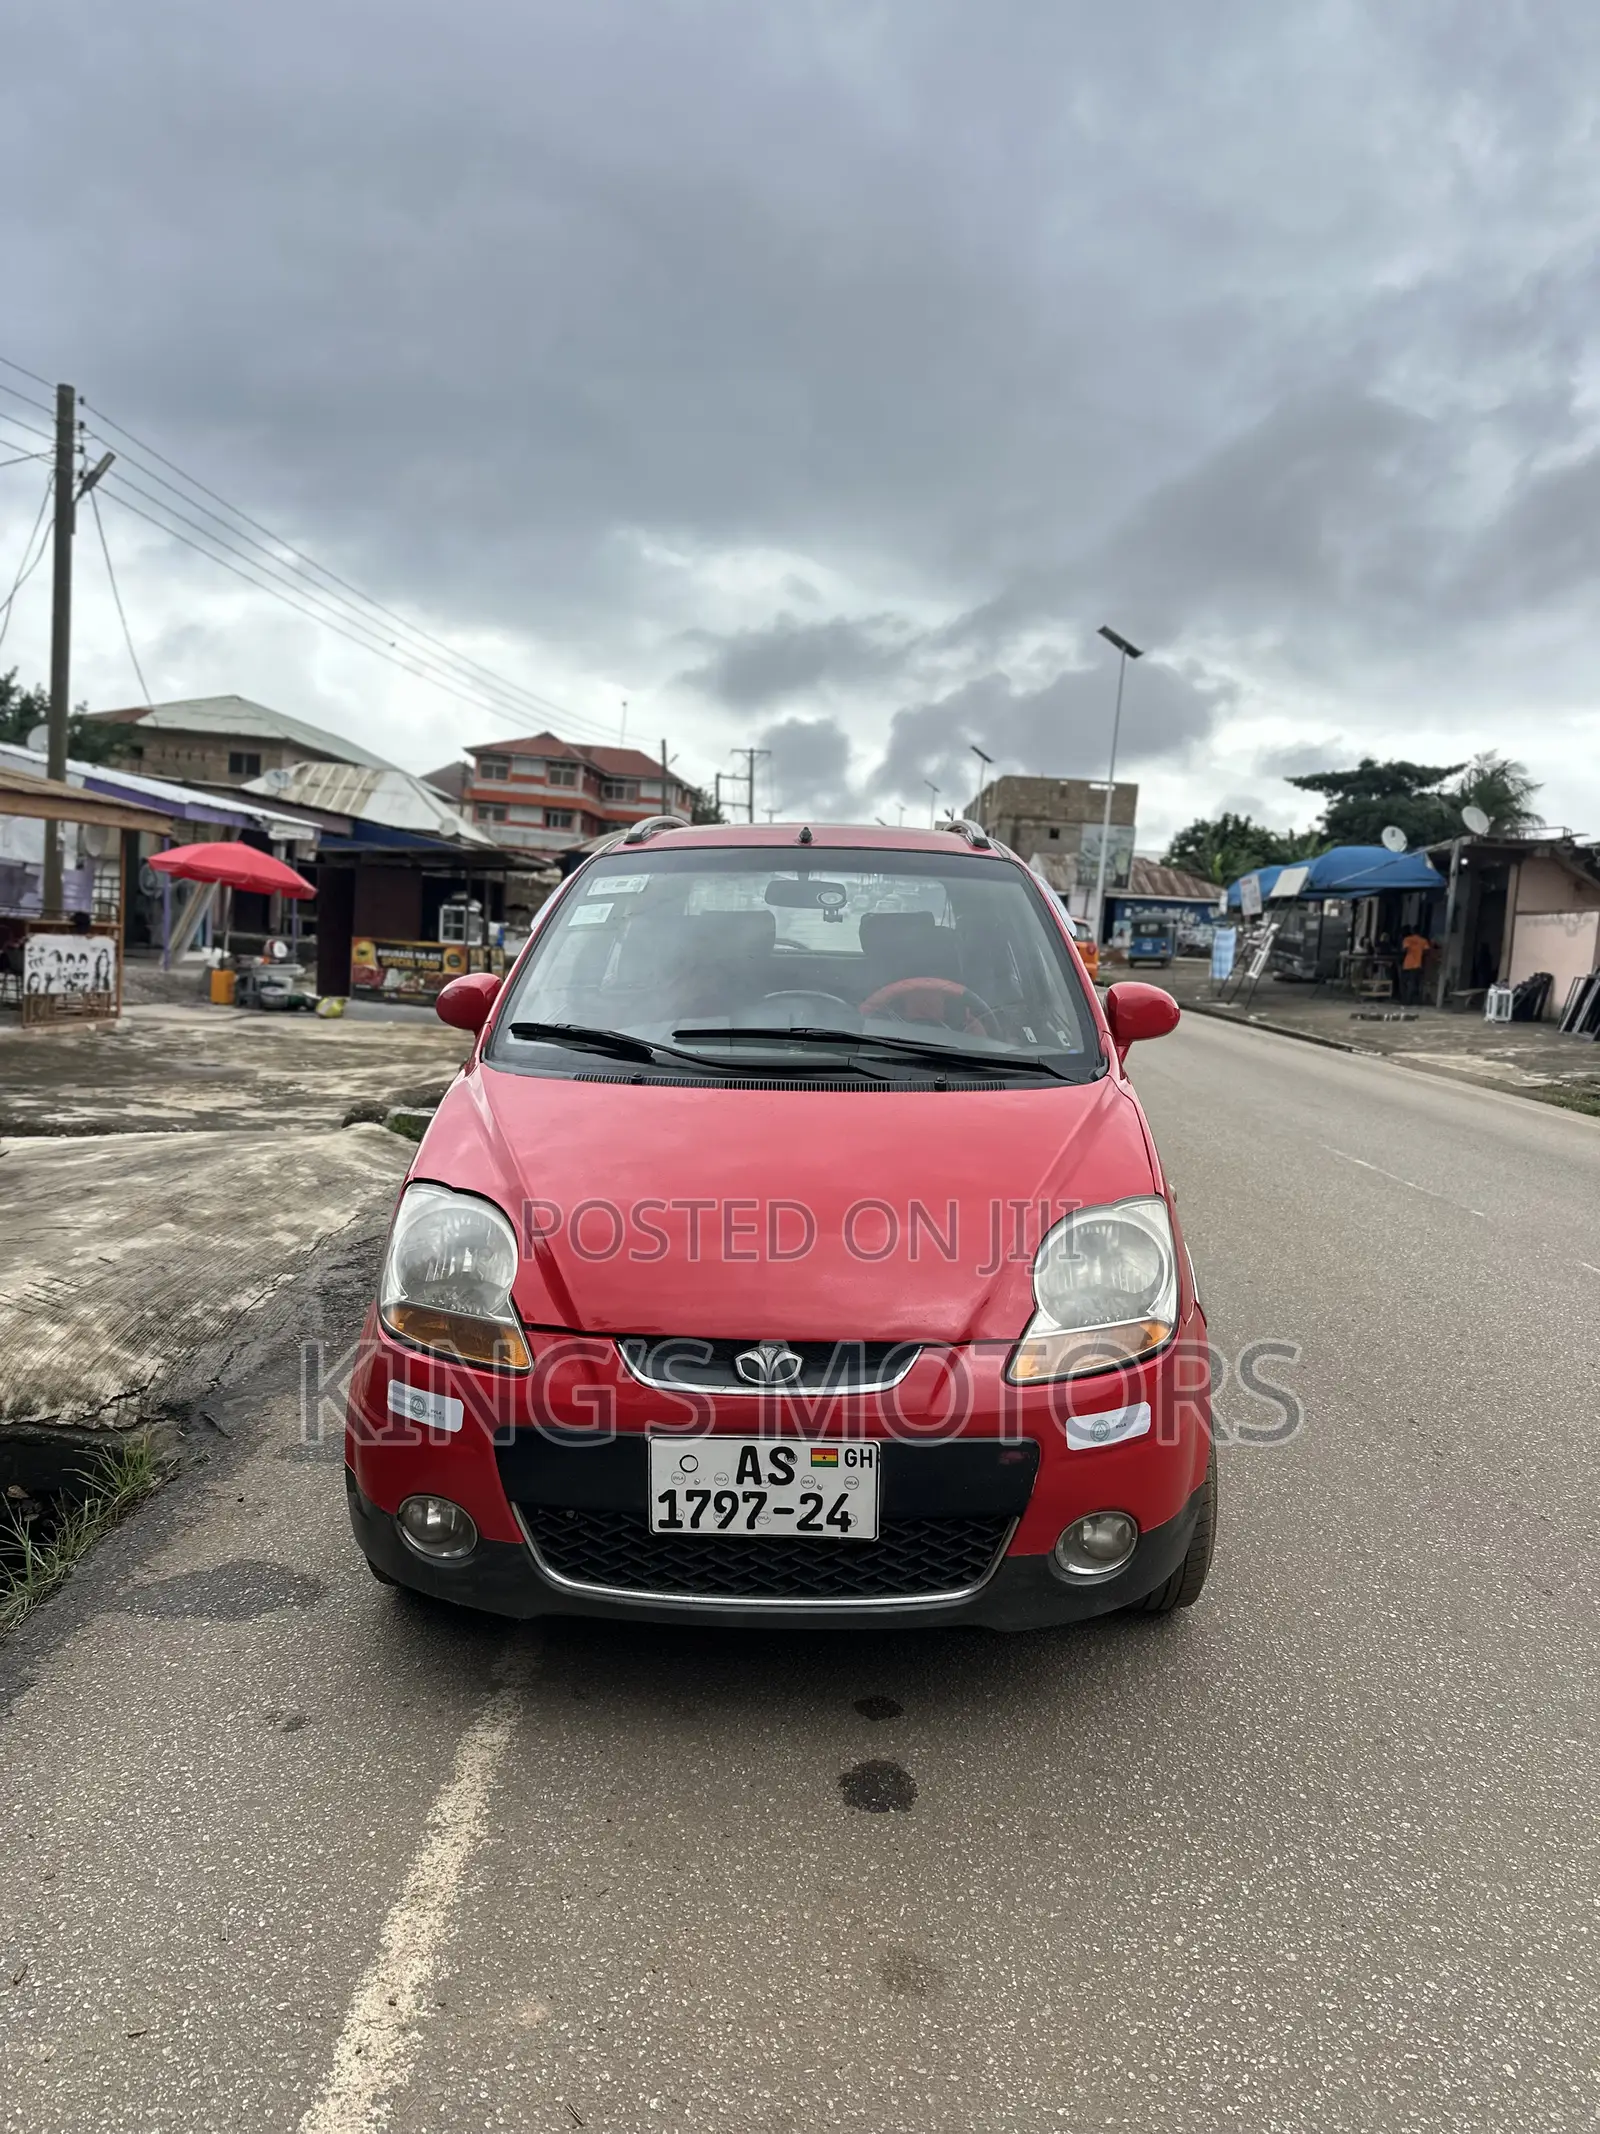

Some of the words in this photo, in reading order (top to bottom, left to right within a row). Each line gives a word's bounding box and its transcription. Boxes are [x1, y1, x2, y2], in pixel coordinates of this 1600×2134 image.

[382, 956, 414, 967] SPECIAL
[418, 959, 440, 969] FOOD
[736, 1445, 795, 1486] AS
[844, 1448, 873, 1468] GH
[658, 1489, 852, 1533] 1797-24
